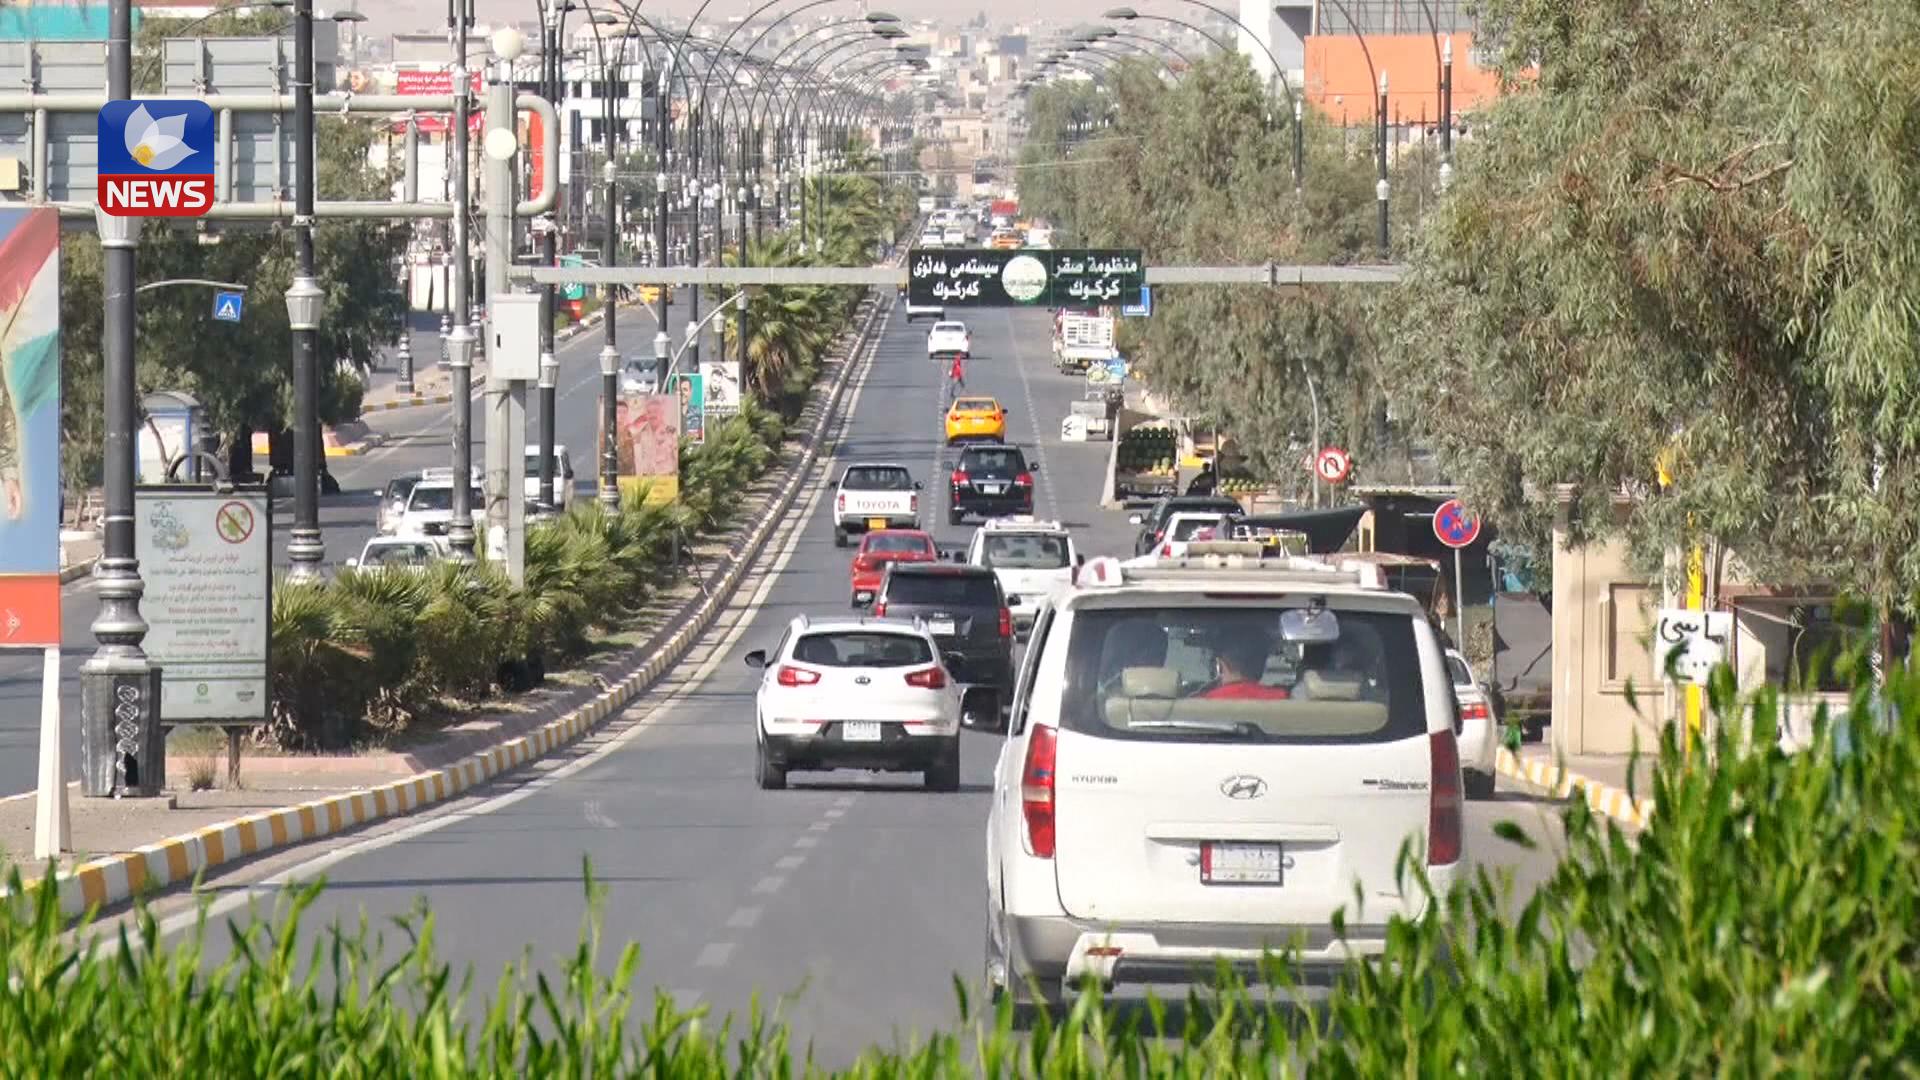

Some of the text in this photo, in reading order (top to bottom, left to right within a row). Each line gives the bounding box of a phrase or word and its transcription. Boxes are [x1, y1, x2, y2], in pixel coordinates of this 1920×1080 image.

[1052, 256, 1138, 278] منظومة صقر
[856, 499, 900, 510] TOYOTA
